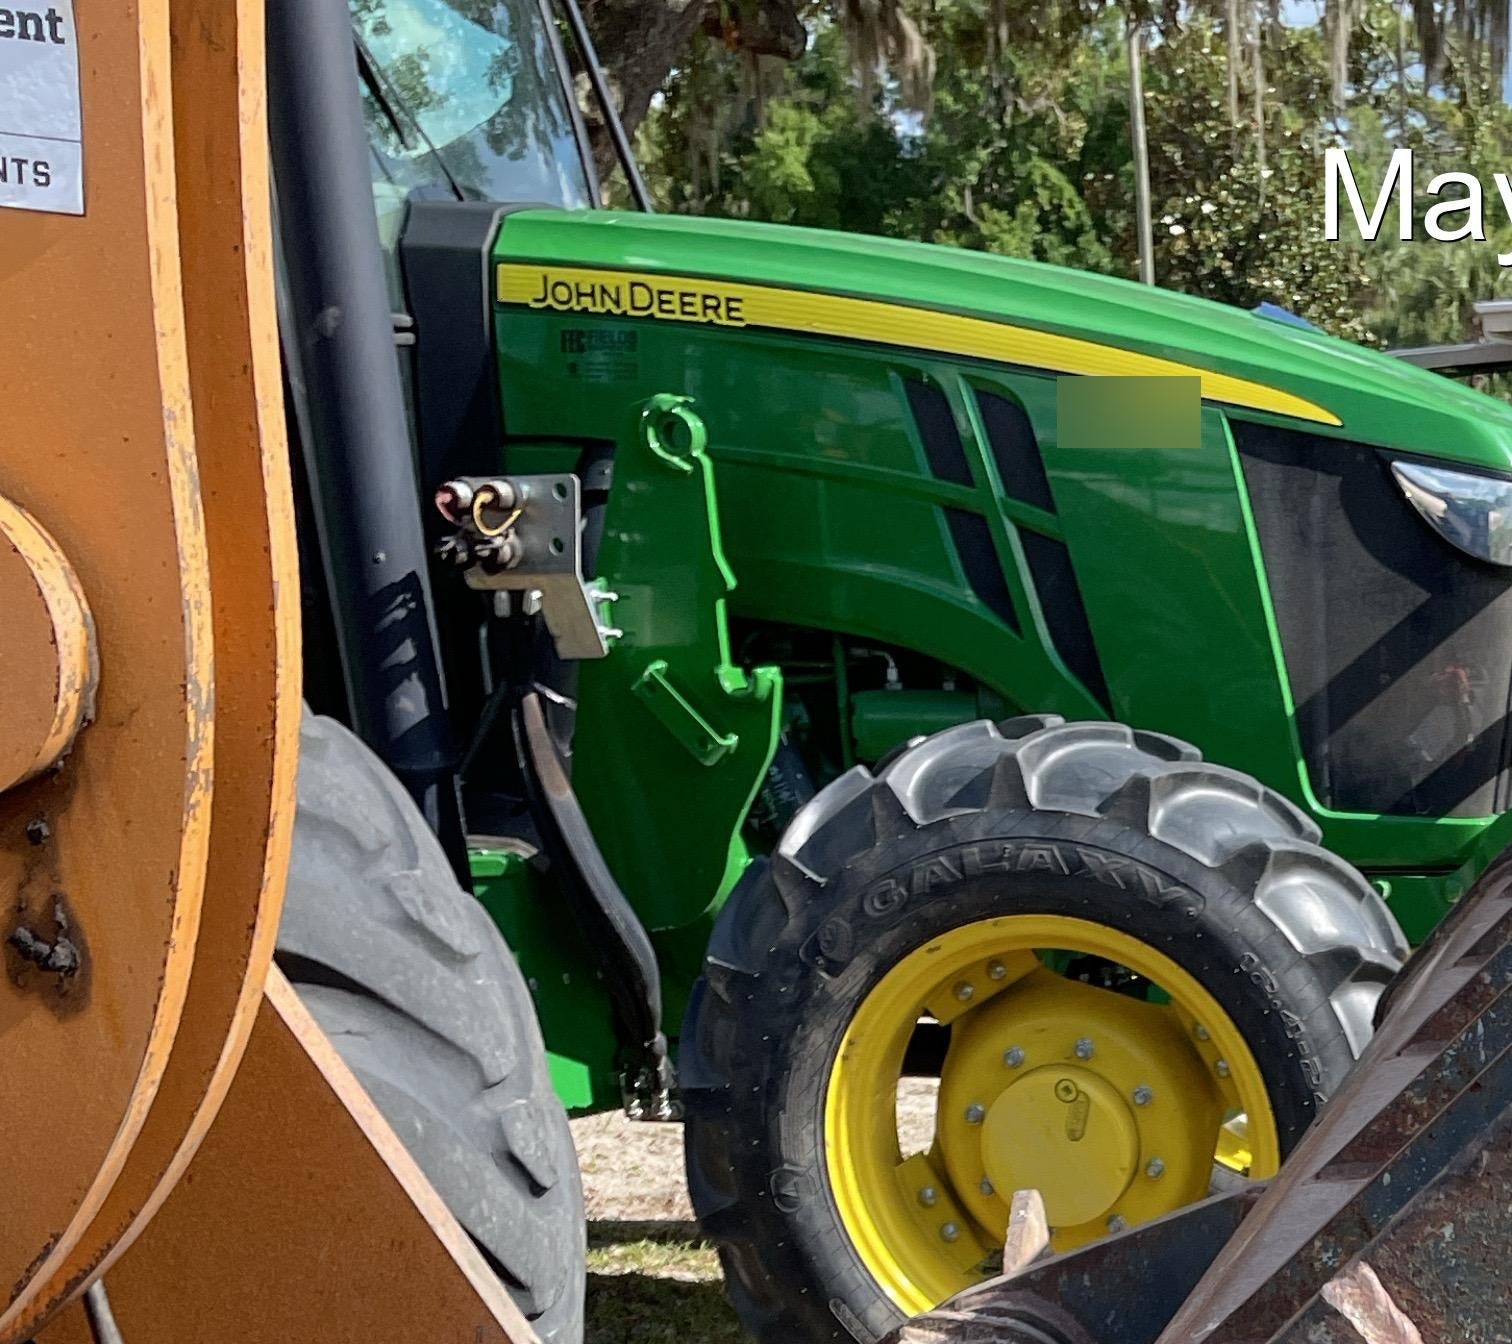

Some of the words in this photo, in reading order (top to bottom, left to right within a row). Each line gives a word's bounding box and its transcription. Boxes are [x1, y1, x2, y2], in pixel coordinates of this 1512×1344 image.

[532, 274, 622, 310] JOHN
[628, 281, 745, 322] DEERE
[863, 843, 1191, 917] GALAXY
